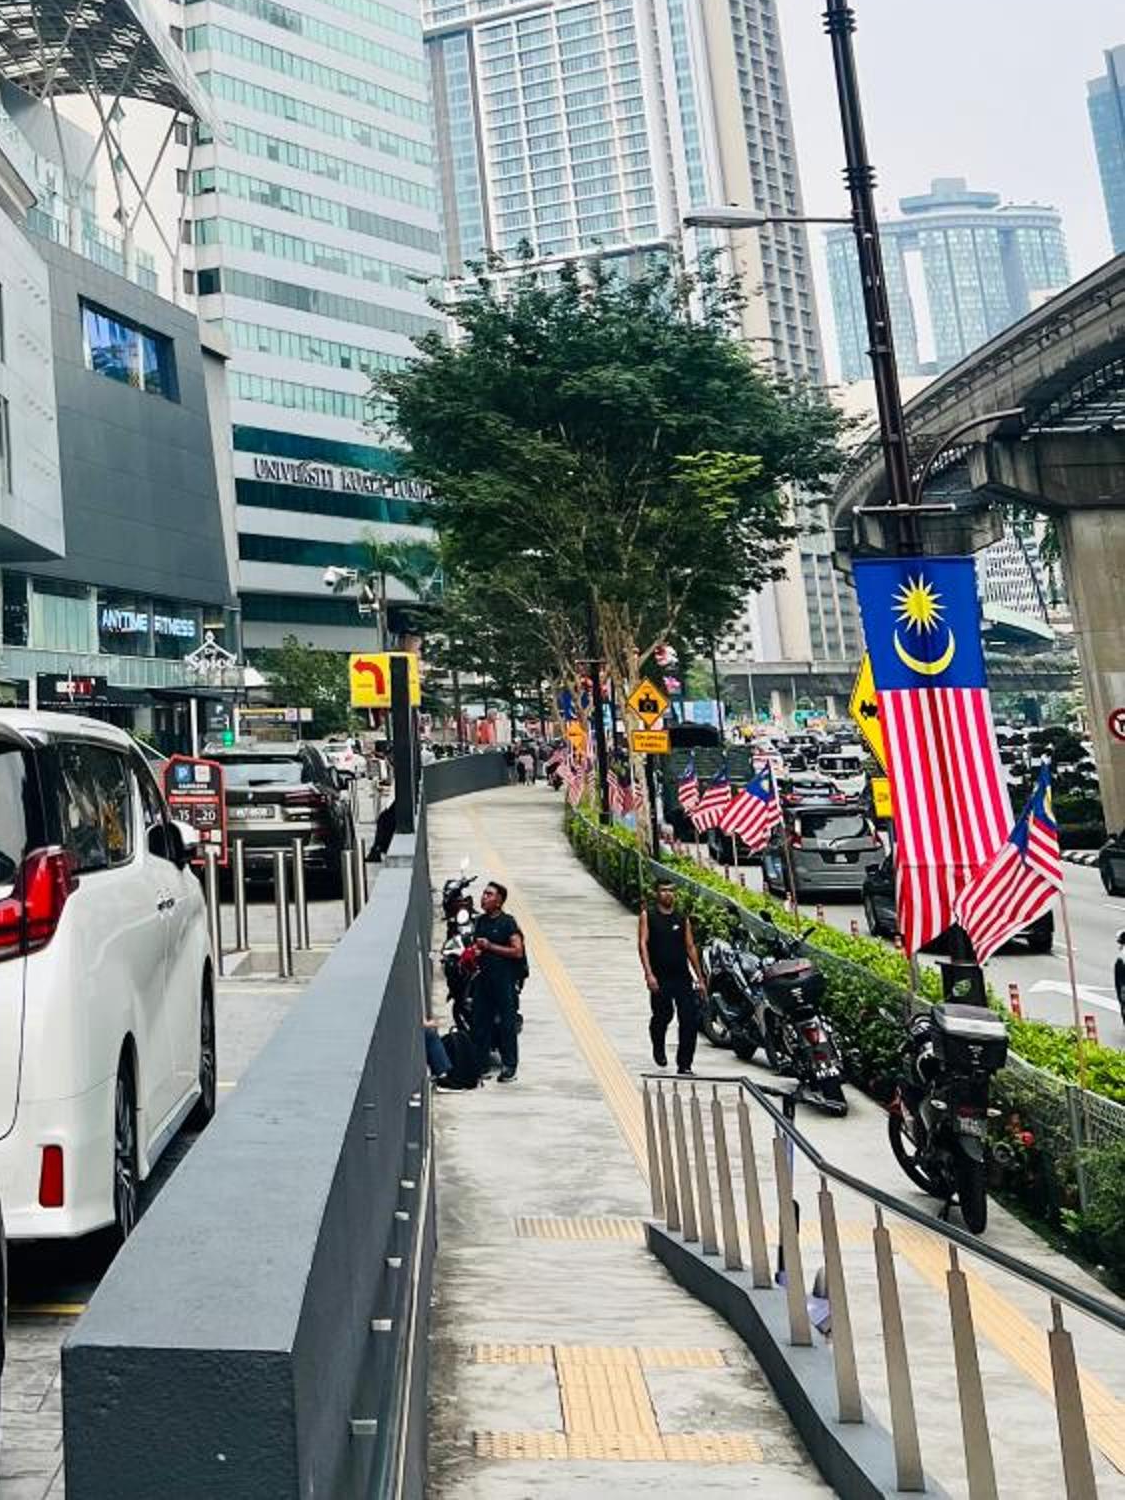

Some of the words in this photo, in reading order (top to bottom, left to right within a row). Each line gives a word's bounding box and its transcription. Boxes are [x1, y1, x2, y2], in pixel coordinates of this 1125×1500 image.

[102, 607, 148, 632] ANYTIME
[153, 614, 197, 638] FITNESS
[202, 810, 216, 821] 20
